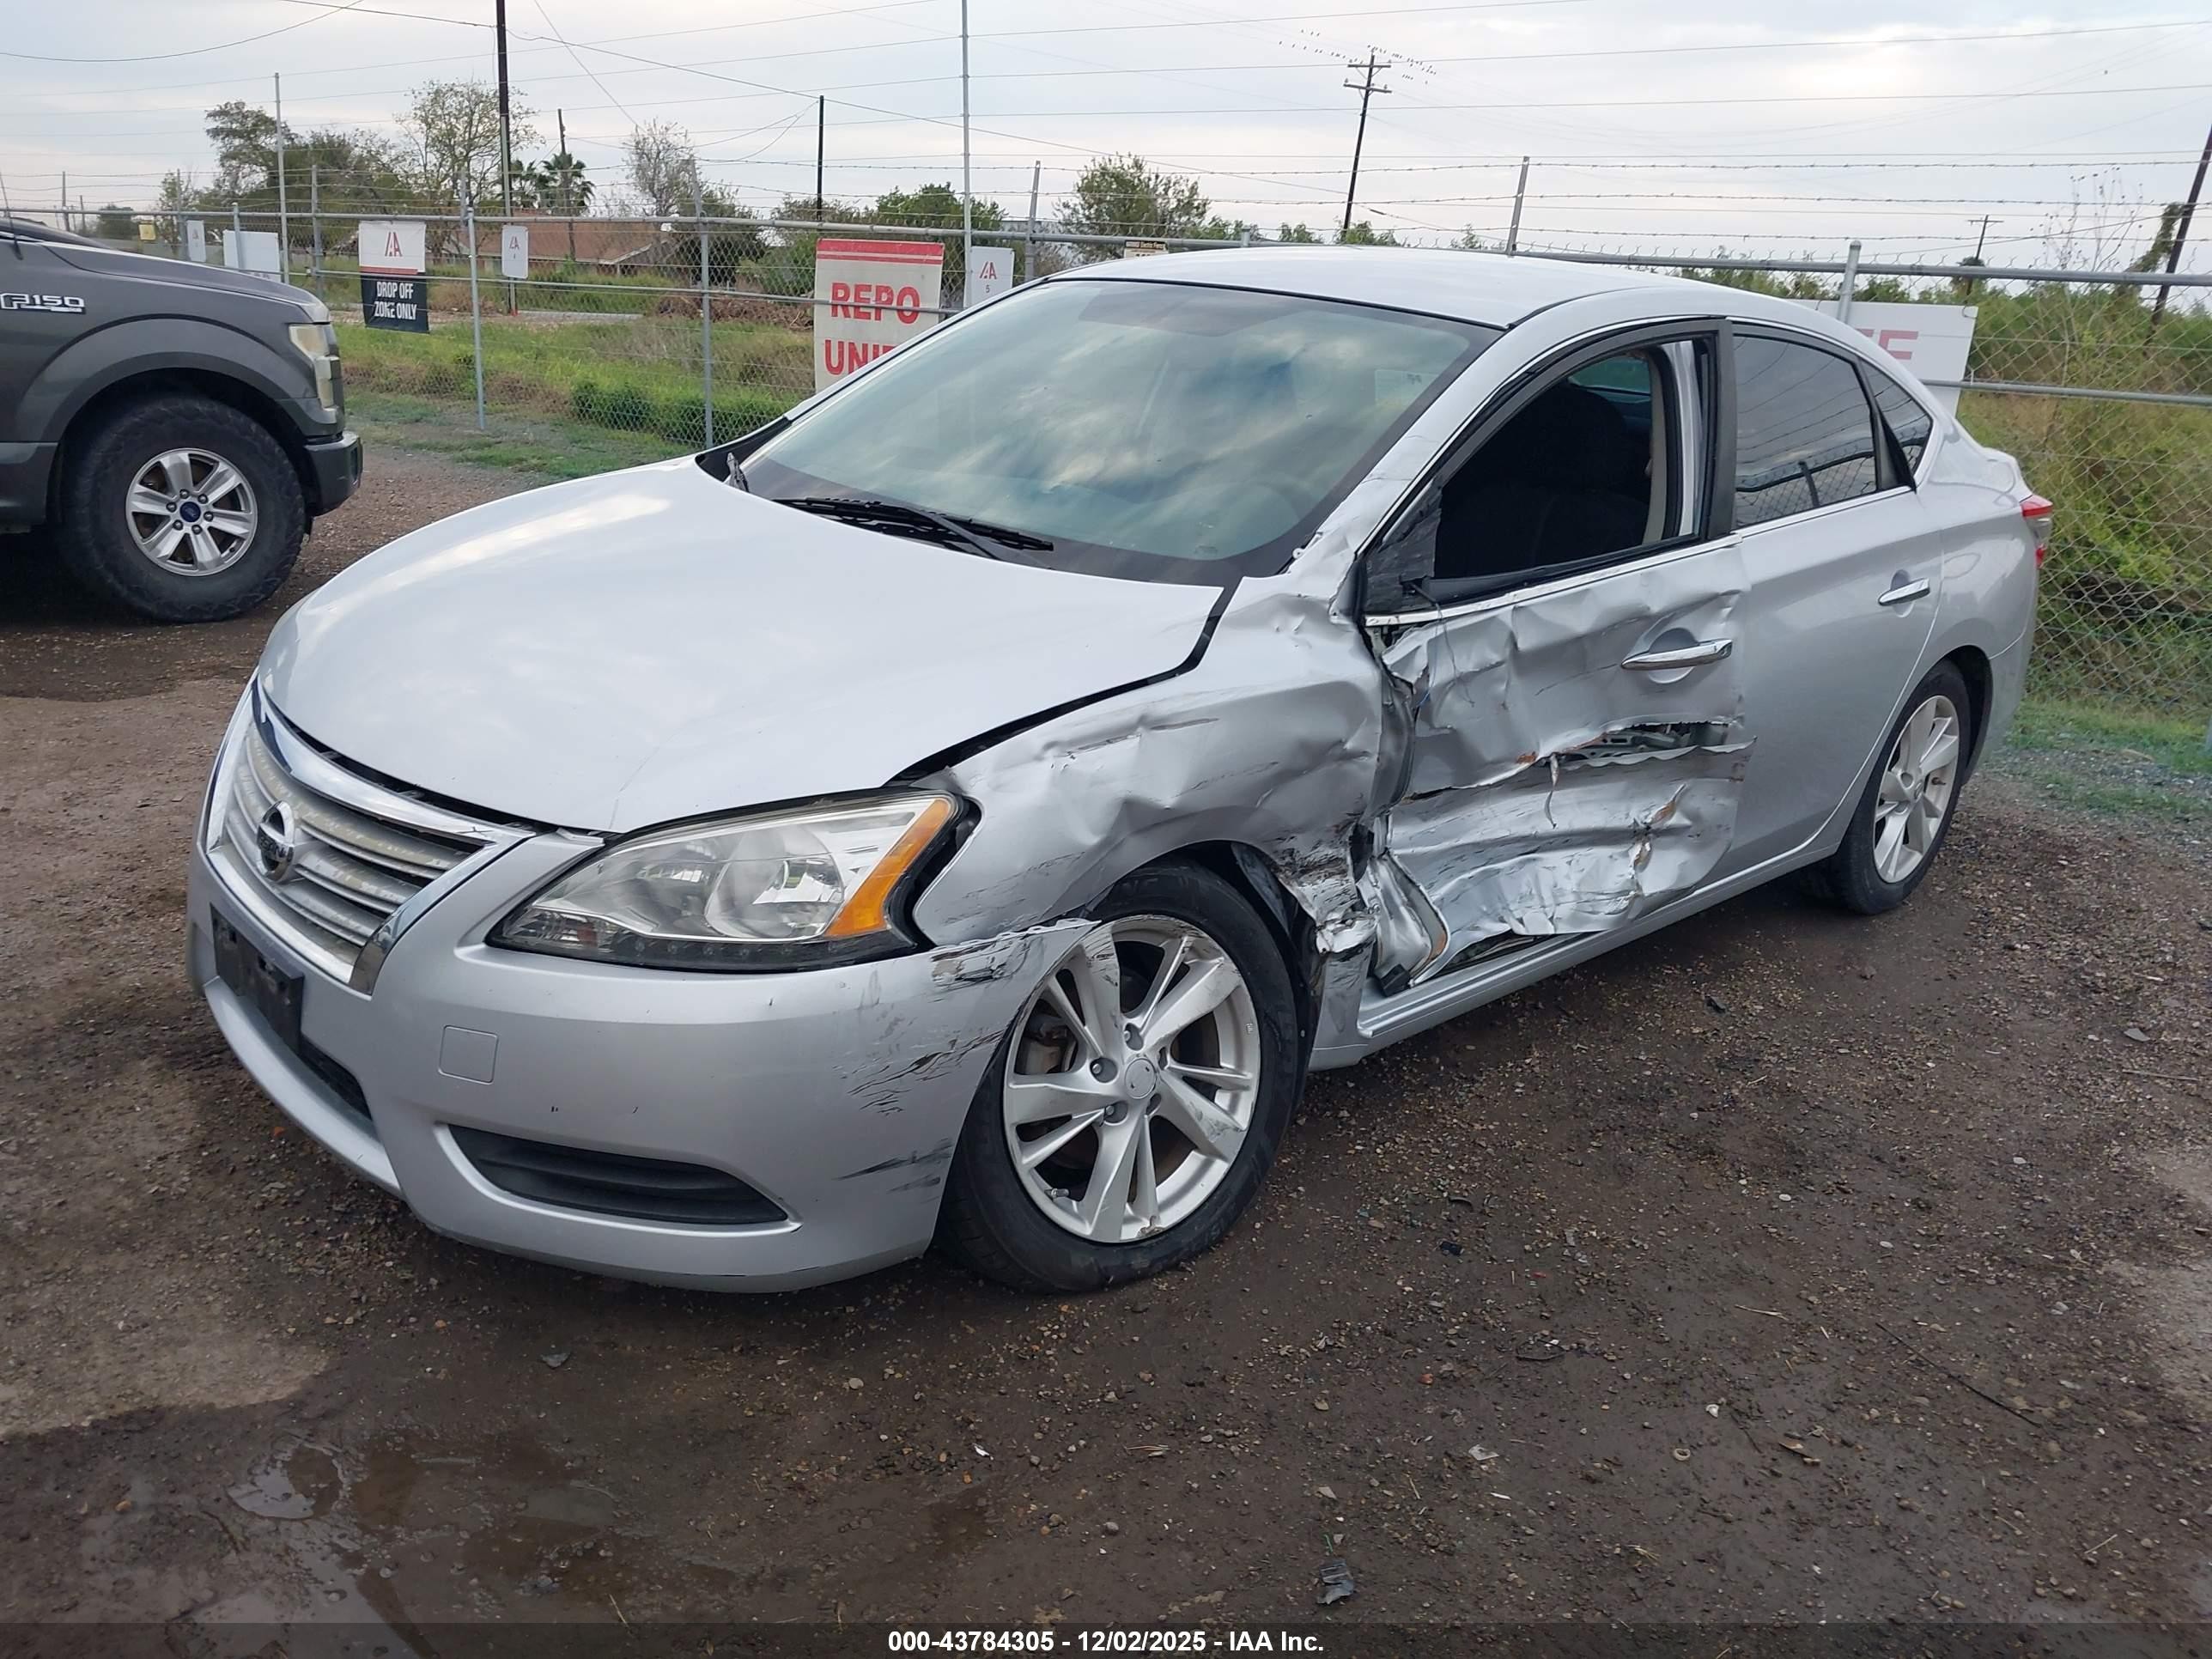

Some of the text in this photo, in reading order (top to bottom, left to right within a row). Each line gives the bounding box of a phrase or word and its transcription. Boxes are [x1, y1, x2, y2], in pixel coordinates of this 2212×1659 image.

[376, 282, 414, 300] DROP OFF
[985, 284, 991, 294] 5
[397, 302, 417, 320] ONLY
[830, 282, 921, 325] REPO
